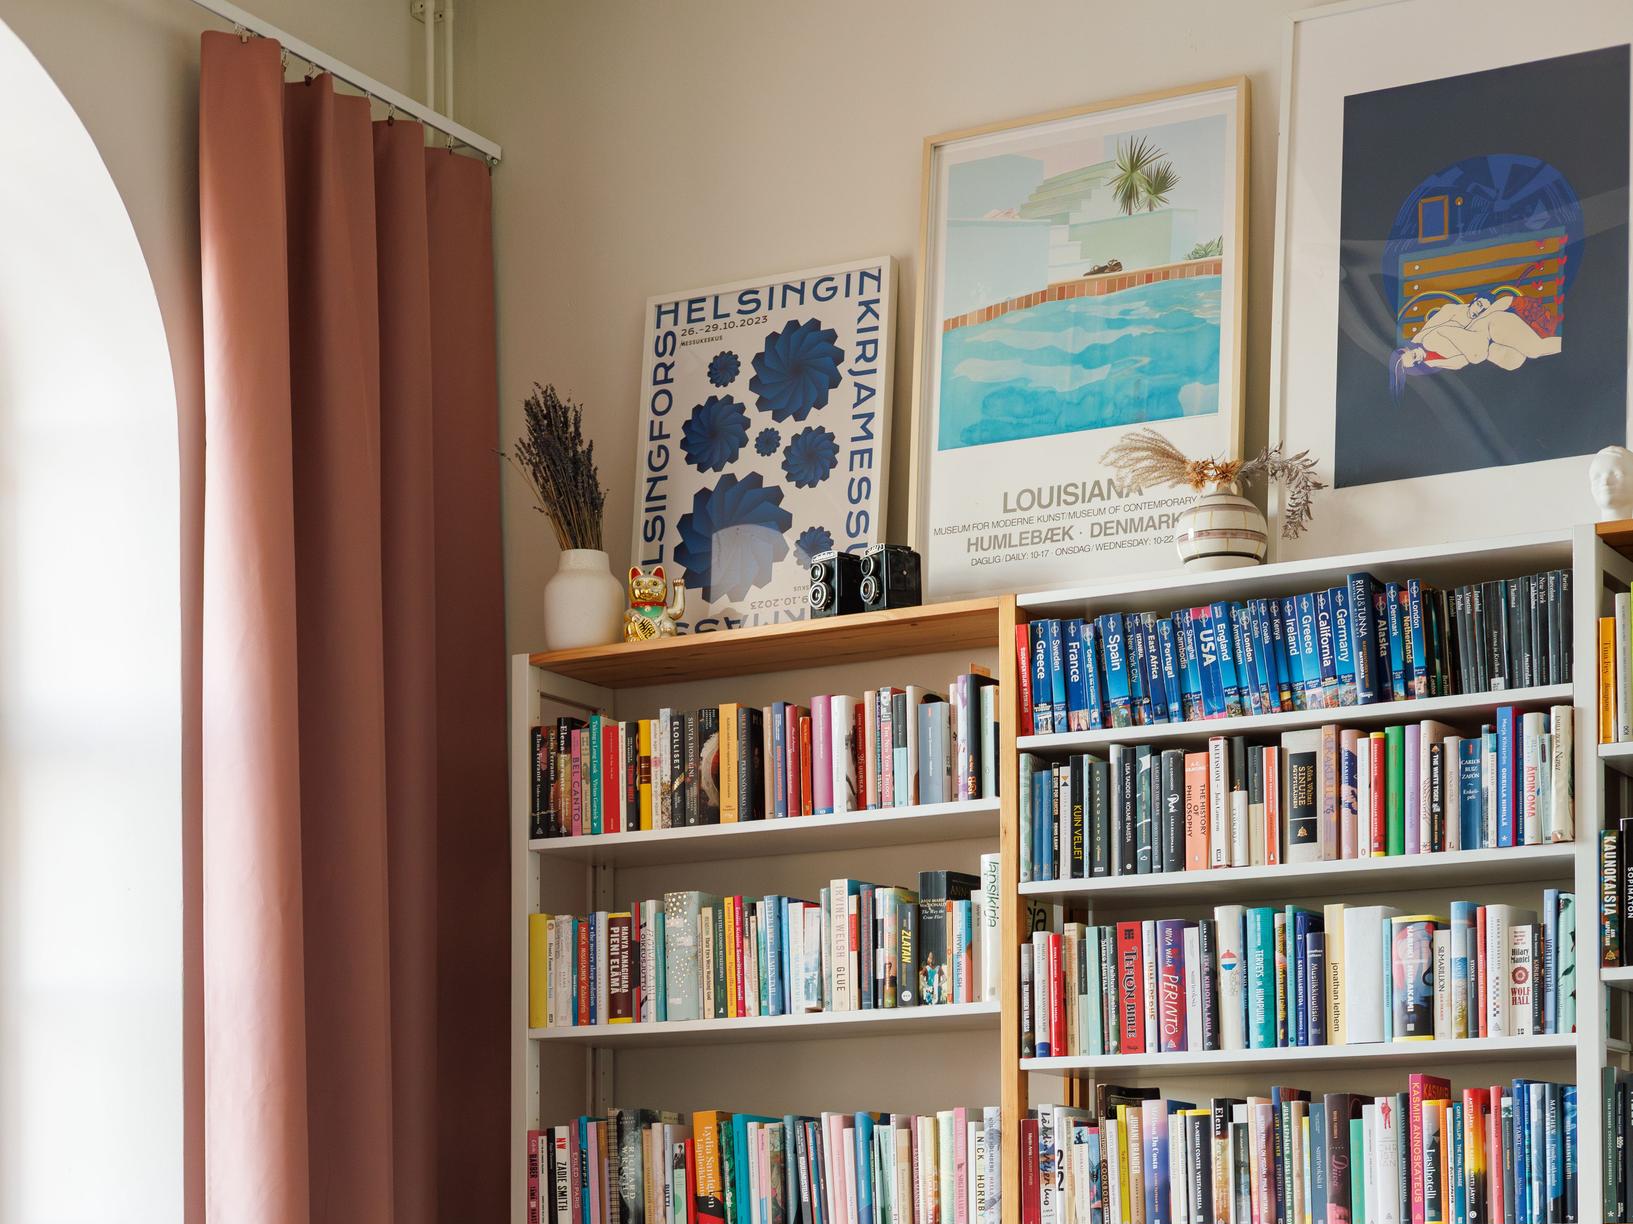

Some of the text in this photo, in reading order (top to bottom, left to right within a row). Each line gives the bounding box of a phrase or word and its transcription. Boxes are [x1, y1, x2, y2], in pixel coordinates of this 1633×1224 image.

[655, 268, 882, 330] HELSINGIN
[680, 315, 769, 338] 26.-29.10.2023
[641, 329, 679, 567] LSINGFORS
[933, 523, 971, 537] MUSEUM
[972, 521, 990, 532] FOR
[992, 516, 1035, 530] MODERNE
[1108, 505, 1121, 515] OF
[1123, 495, 1199, 513] CONTEMPORARY
[967, 511, 1184, 553] HUMLEBÆK DENMARK
[1031, 549, 1050, 560] 10-17
[1055, 544, 1091, 557] ONSDAG
[1095, 537, 1152, 552] WEDNESDAY:
[1153, 534, 1175, 546] 10-22
[1412, 600, 1420, 629] London
[1465, 592, 1473, 614] Venetsia
[1186, 630, 1196, 660] Shanghai
[1200, 630, 1216, 666] USA
[1217, 624, 1230, 661] England
[1232, 624, 1243, 665] Amsterdam
[1244, 633, 1253, 662] London
[1273, 619, 1281, 640] Kenya
[1286, 618, 1299, 656] Ireland
[1302, 615, 1313, 654] Greece
[1318, 612, 1332, 667] California
[1336, 609, 1350, 662] Germany
[1378, 620, 1388, 657] Alaska
[1403, 616, 1413, 663] Netherlands
[1037, 640, 1045, 679] Greece
[1069, 642, 1080, 682] France
[1107, 635, 1122, 671] Spain
[1148, 636, 1159, 679] East Africa
[1164, 642, 1174, 678] Portugal
[1176, 631, 1188, 669] Cambodia
[1073, 805, 1082, 860] KUIN VELJET
[983, 861, 999, 928] lapsikirja
[1603, 836, 1616, 915] KAUNOKAISIA
[836, 886, 845, 992] IRVINE WELSH GLUE
[901, 930, 911, 963] ZLATAN
[1511, 948, 1530, 957] Hilary
[610, 927, 621, 994] PIENI ELÄMÄ
[1510, 955, 1530, 964] Mantel
[1122, 947, 1137, 1038] TEFLON BIBLE
[1163, 974, 1179, 1035] PERINTÖ
[1255, 949, 1264, 1024] TERVEYS HUMPUUKI
[1331, 961, 1341, 1032] jonathan lethem
[1510, 987, 1531, 997] WOLF
[1511, 996, 1531, 1006] HALL
[704, 1126, 713, 1154] Lydia
[1130, 1115, 1139, 1139] JUHANI
[1215, 1107, 1224, 1136] Elena
[556, 1138, 566, 1150] NW
[1412, 1082, 1422, 1203] KASMIR ANNOSKATEUS
[557, 1162, 568, 1211] ZADIE SMITH
[1043, 1188, 1053, 1206] luo
